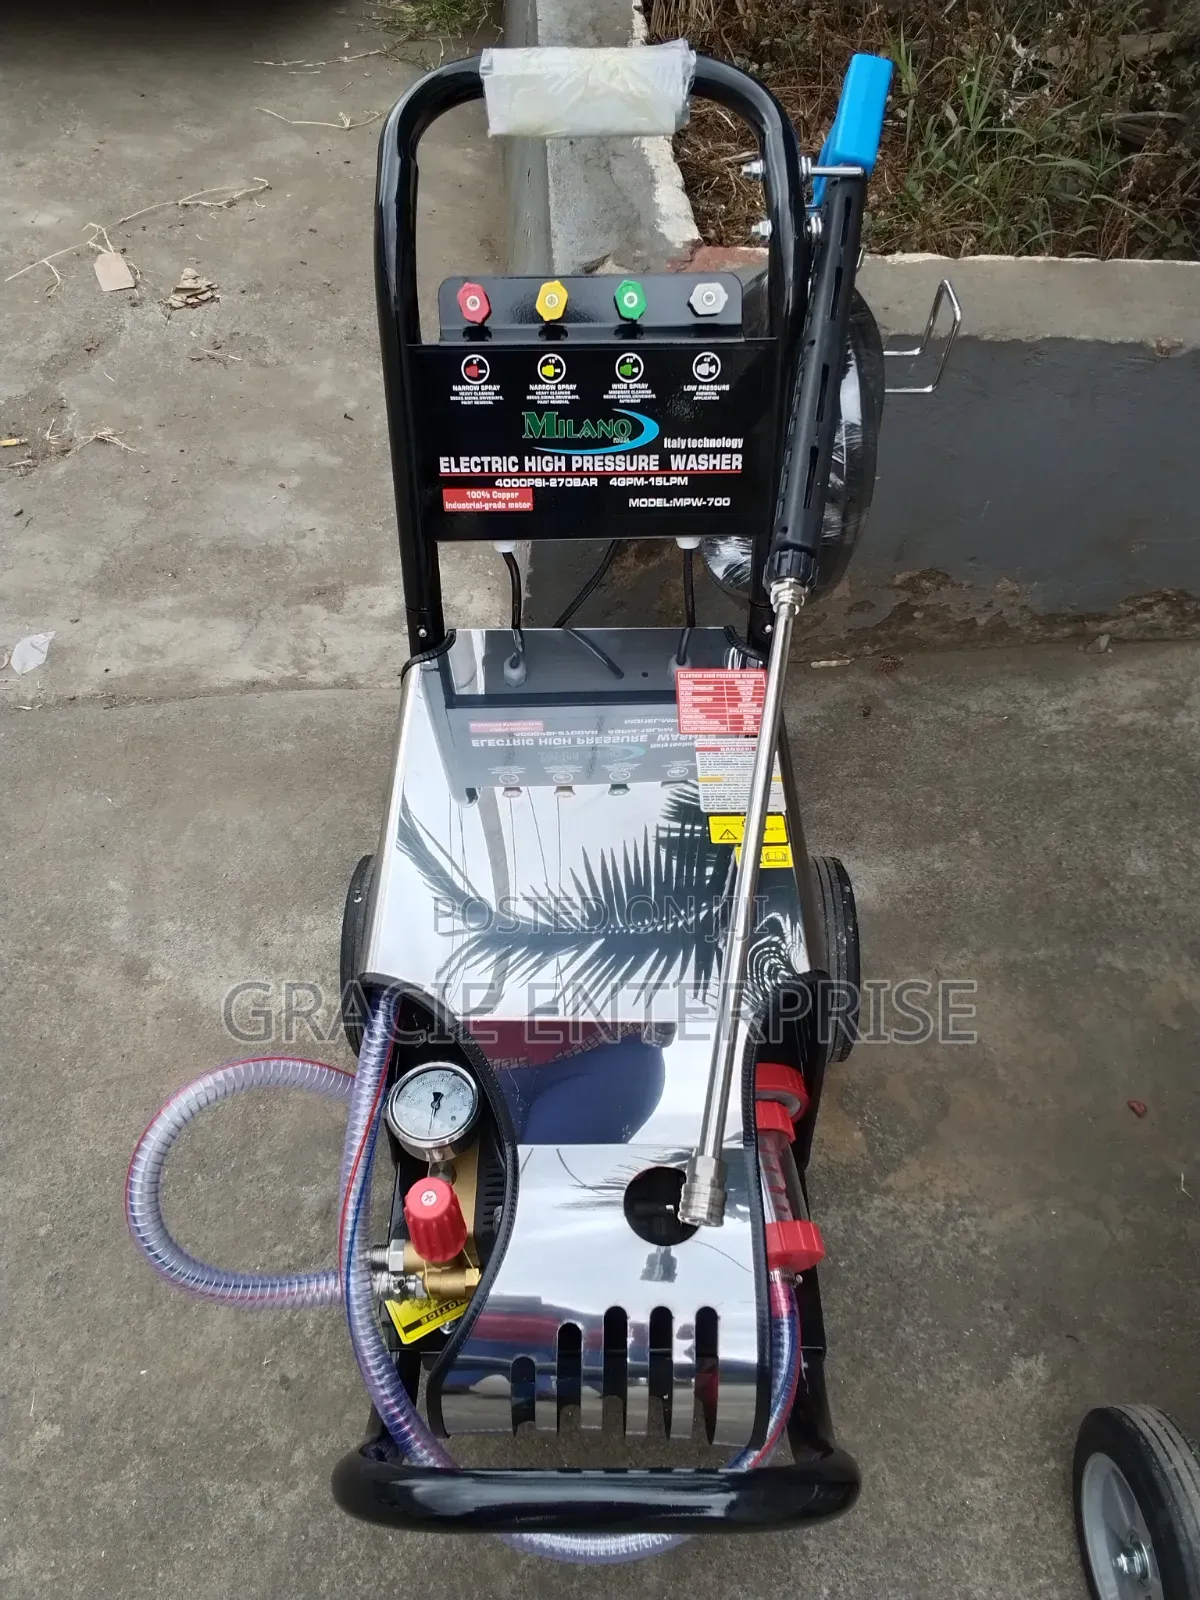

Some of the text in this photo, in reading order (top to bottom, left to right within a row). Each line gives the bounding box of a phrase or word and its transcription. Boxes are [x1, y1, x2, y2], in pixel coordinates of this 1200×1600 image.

[663, 437, 744, 449] Italy technology
[439, 454, 743, 473] ELECTRIC HIGH PRESSURE WASHER
[494, 476, 689, 488] 4000PSI-270BAR 4GPM-15LPM
[466, 491, 519, 499] 100% Copper
[445, 501, 506, 510] Industrial-grade
[628, 497, 731, 508] MODEL:MPW-700
